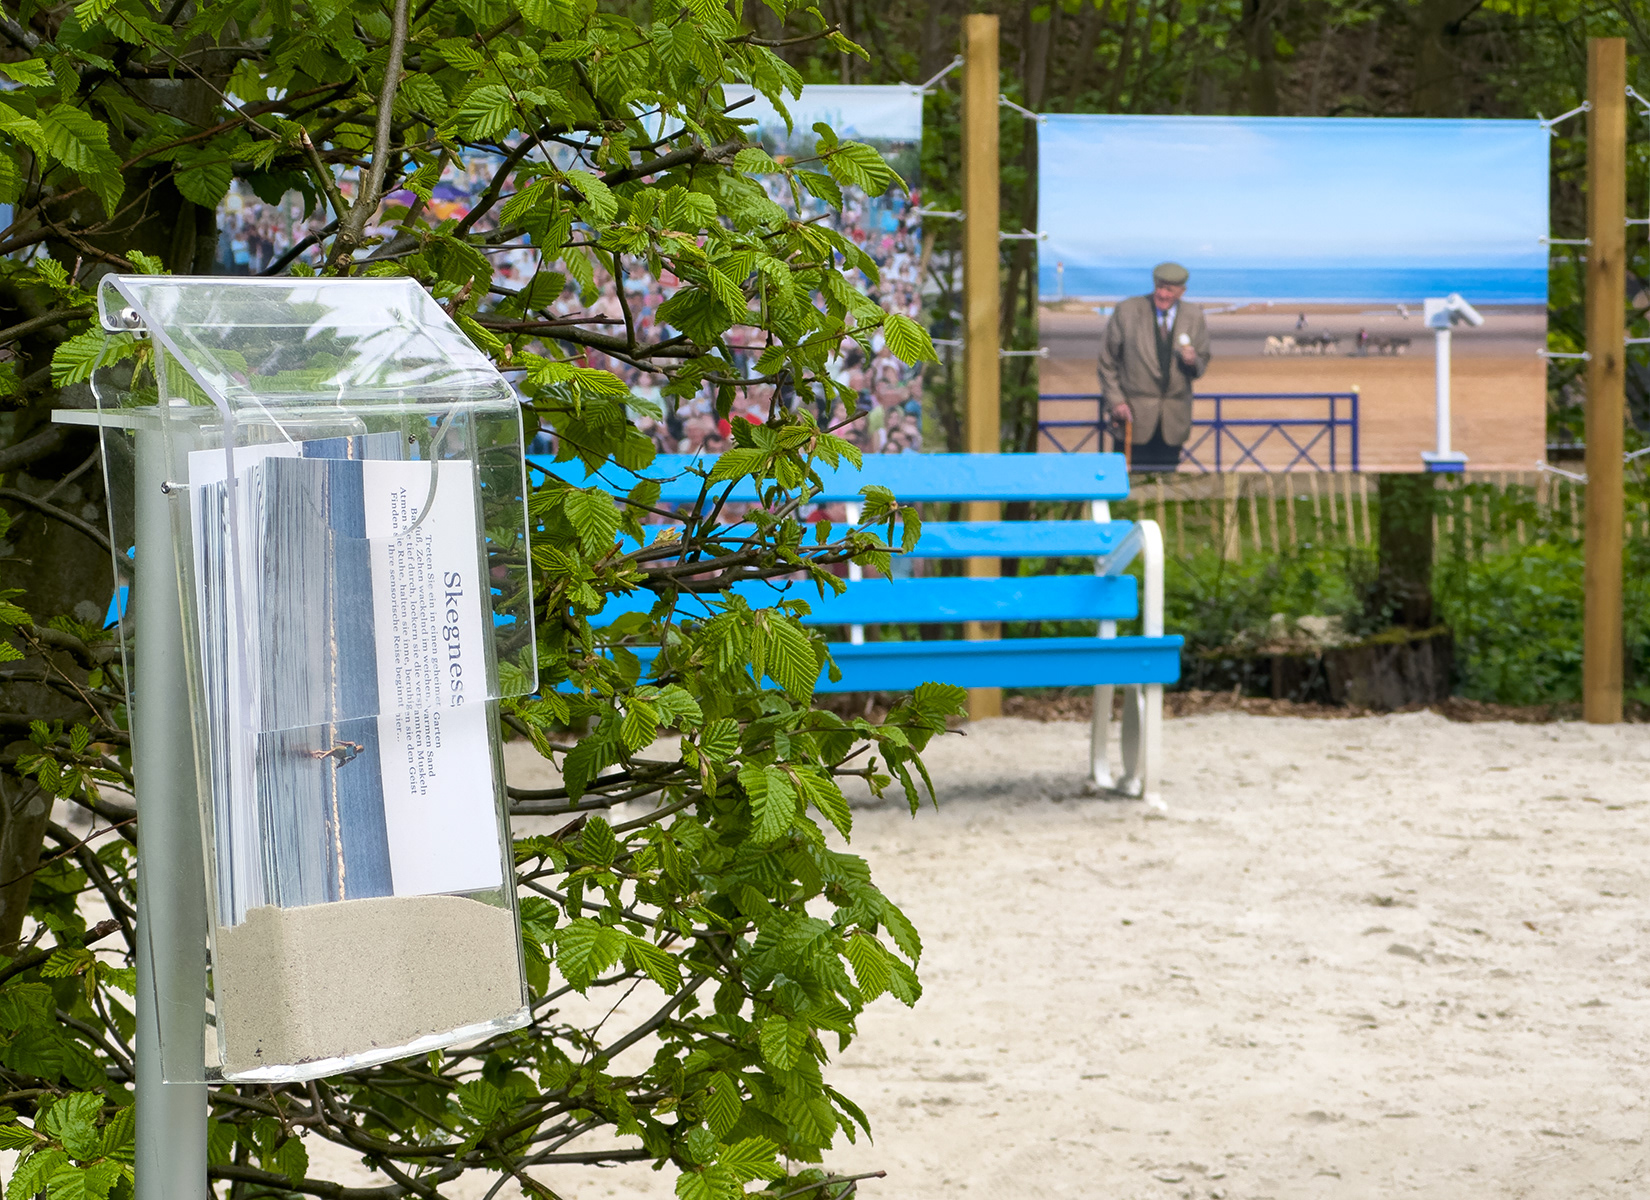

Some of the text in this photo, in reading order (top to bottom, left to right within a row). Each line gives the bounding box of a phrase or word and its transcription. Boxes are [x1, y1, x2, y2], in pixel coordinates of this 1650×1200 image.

[390, 492, 399, 529] Finden
[399, 486, 407, 522] Atmen
[402, 525, 411, 540] se
[411, 508, 423, 547] Bafuß,
[388, 544, 396, 567] Ihre
[397, 550, 405, 581] Ruhe,
[406, 542, 415, 562] tief
[416, 549, 424, 582] Zehen
[425, 534, 433, 570] Treten
[407, 563, 417, 598] durch,
[427, 573, 435, 590] Sie
[389, 569, 400, 632] sensorische
[399, 584, 407, 618] halten
[419, 585, 428, 634] wackelnd
[430, 612, 437, 622] in
[410, 601, 419, 640] lockern
[422, 638, 428, 653] im
[443, 572, 465, 707] Skegness
[394, 667, 404, 707] beginnt
[413, 661, 421, 678] die
[414, 681, 423, 747] verspannten
[433, 712, 441, 749] Garten
[408, 766, 417, 794] Geist
[417, 750, 428, 796] Muskeln
[426, 750, 436, 777] Sand
